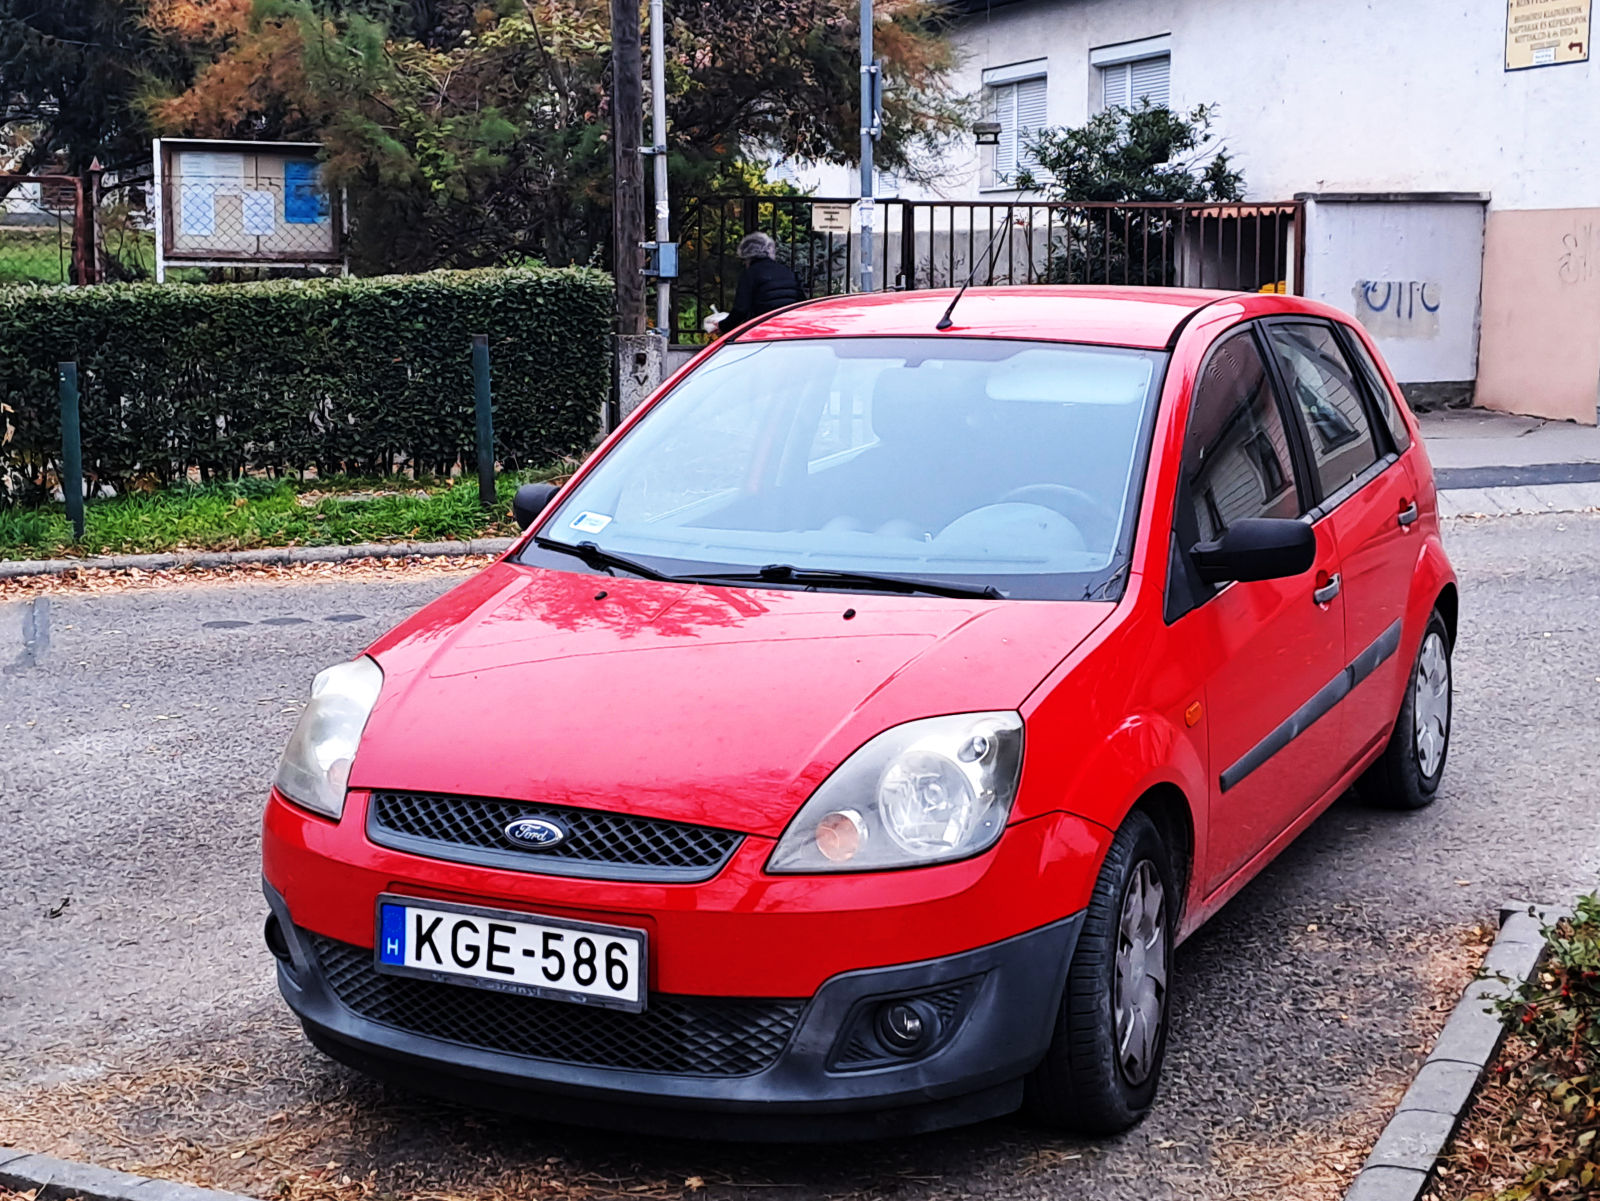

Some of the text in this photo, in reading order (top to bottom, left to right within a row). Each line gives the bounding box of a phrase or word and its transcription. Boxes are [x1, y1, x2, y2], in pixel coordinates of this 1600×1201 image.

[515, 823, 549, 842] Ford
[387, 913, 628, 991] H KGE-586
